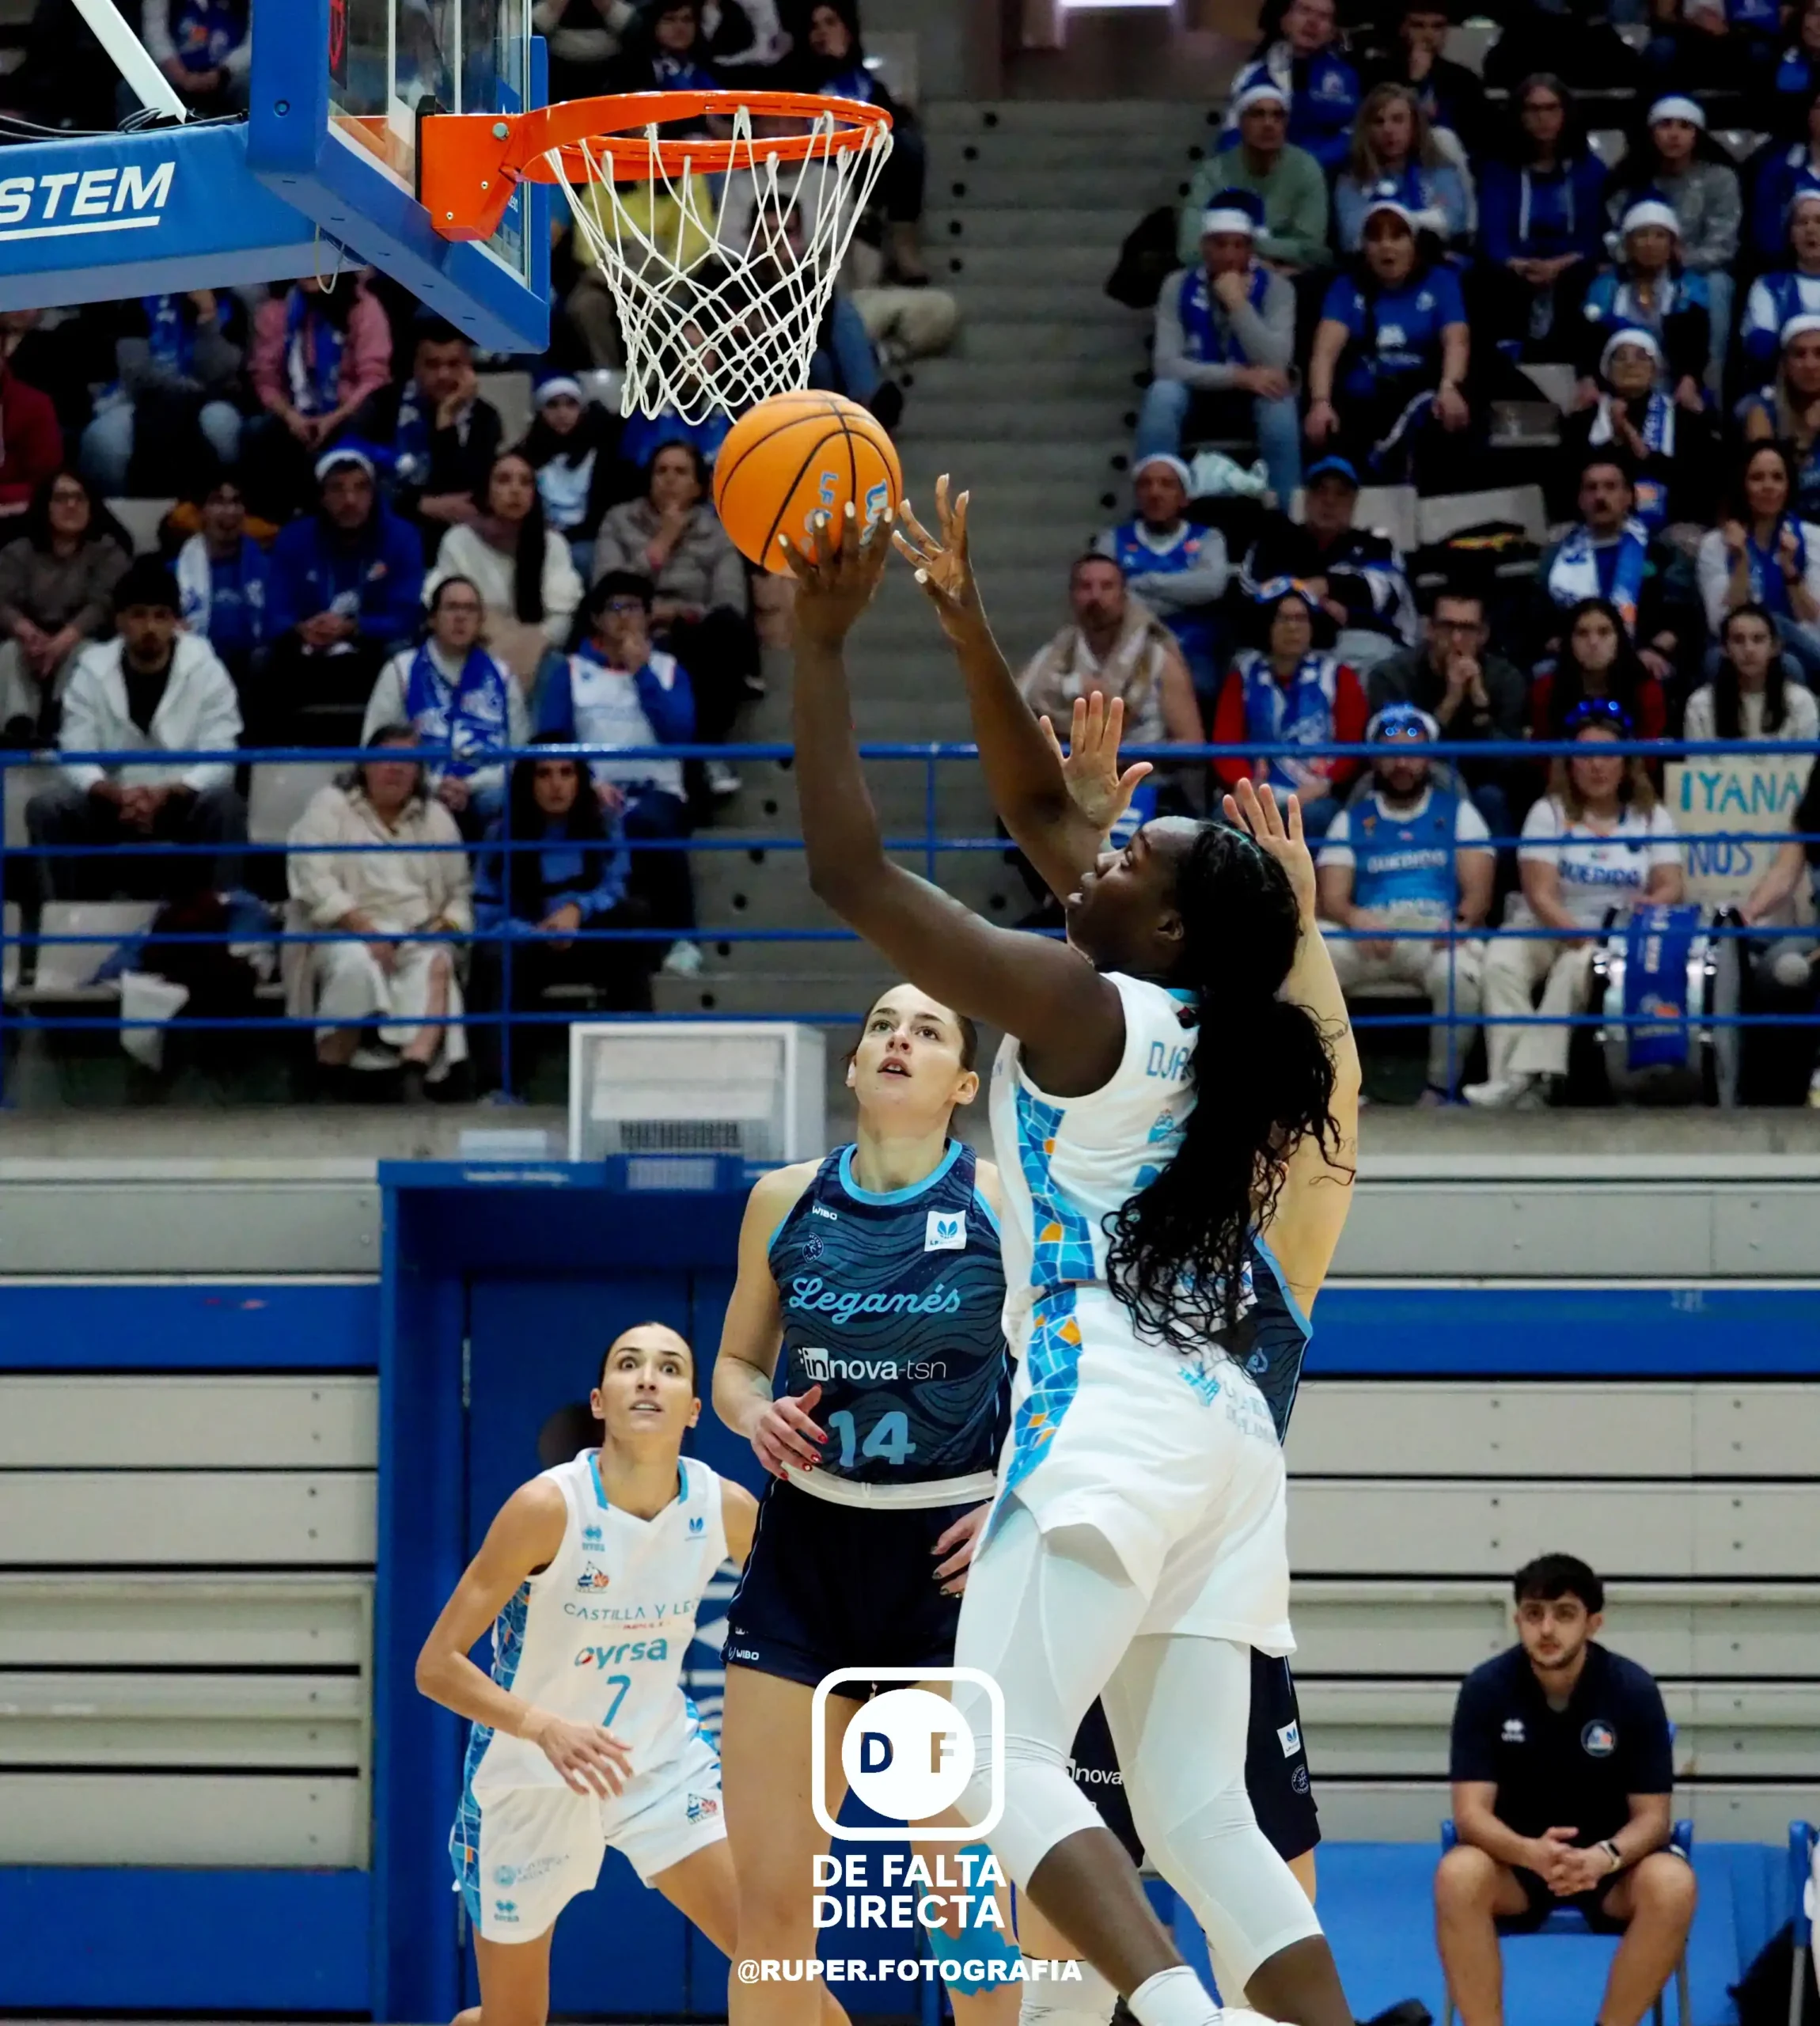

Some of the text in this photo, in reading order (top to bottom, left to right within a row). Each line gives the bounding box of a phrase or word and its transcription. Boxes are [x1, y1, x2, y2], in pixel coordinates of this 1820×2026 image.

[0, 161, 176, 224] STEM
[1681, 771, 1803, 815] IYANA
[812, 1205, 838, 1221] WIBO
[790, 1277, 961, 1325] Leganés
[799, 1347, 947, 1382] innova-tsn
[828, 1409, 917, 1468] 14
[563, 1600, 696, 1621] CASTILLA Y LE
[736, 1648, 760, 1661] WIBO
[602, 1675, 631, 1728] 7
